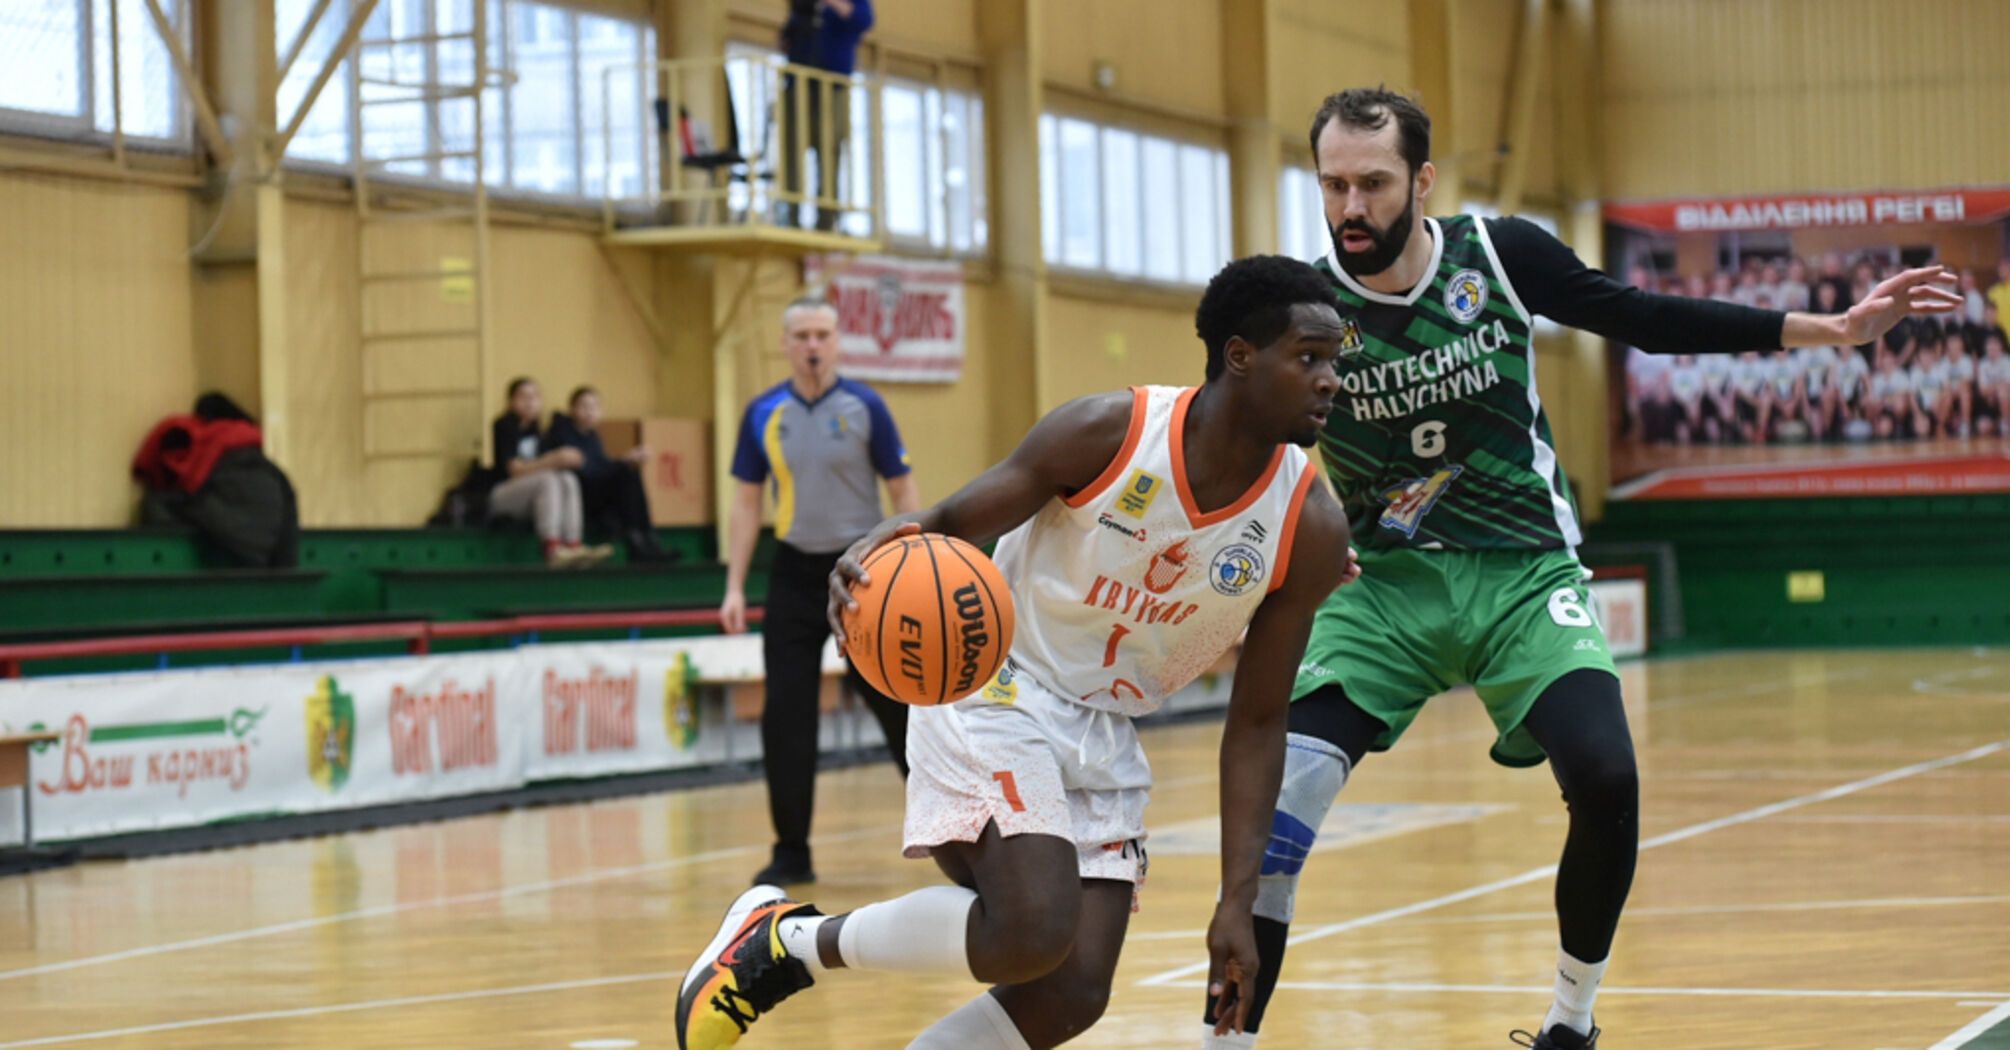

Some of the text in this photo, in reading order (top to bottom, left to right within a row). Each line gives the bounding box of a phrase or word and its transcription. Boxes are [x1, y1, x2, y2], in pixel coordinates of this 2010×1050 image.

[1675, 195, 1965, 231] ВІДДІЛЕННЯ РЕГБІ
[1342, 319, 1511, 394] OLYTECHNICA
[1352, 359, 1500, 422] HALYCHYNA
[1411, 420, 1448, 459] 6
[1547, 587, 1593, 628] 6
[900, 614, 923, 681] EVO
[953, 581, 988, 694] Wilson
[1103, 623, 1131, 667] 1
[38, 712, 250, 799] Ваш карниз
[993, 771, 1026, 813] 1
